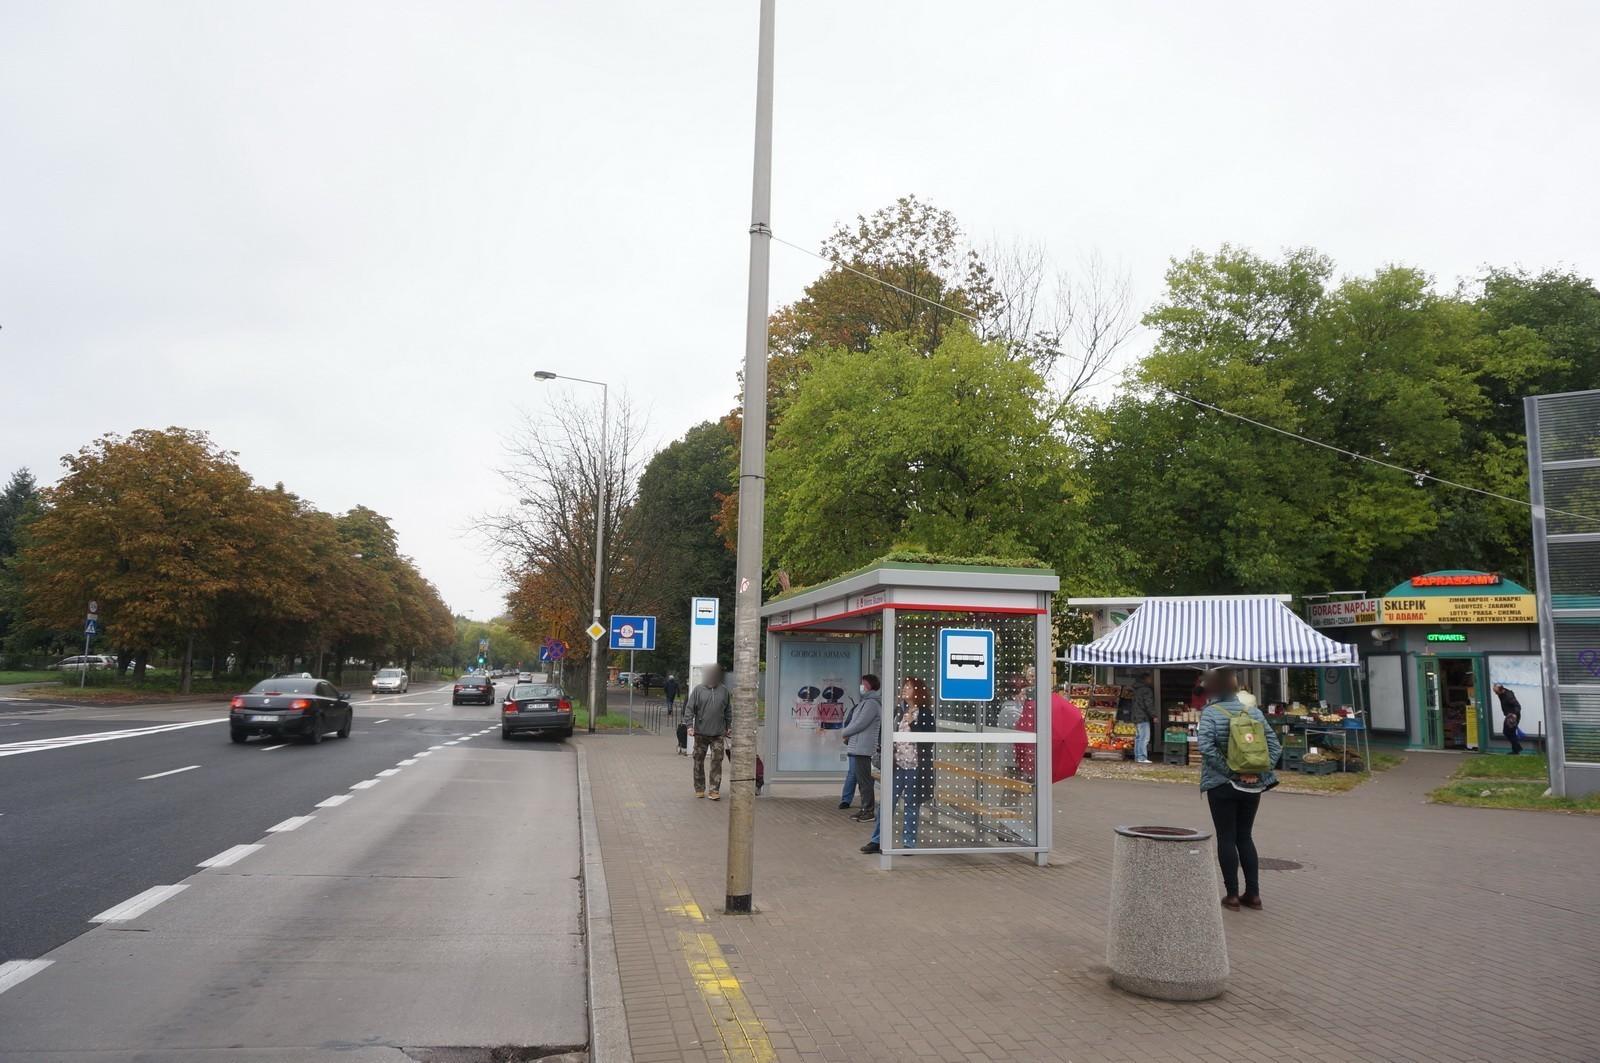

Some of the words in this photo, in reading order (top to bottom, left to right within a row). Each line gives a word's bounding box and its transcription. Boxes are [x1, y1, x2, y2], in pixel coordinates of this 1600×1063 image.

[1344, 600, 1376, 613] NAPOJE
[1384, 600, 1426, 611] SKLEPIK
[791, 707, 813, 717] MY
[817, 707, 848, 717] WAY
